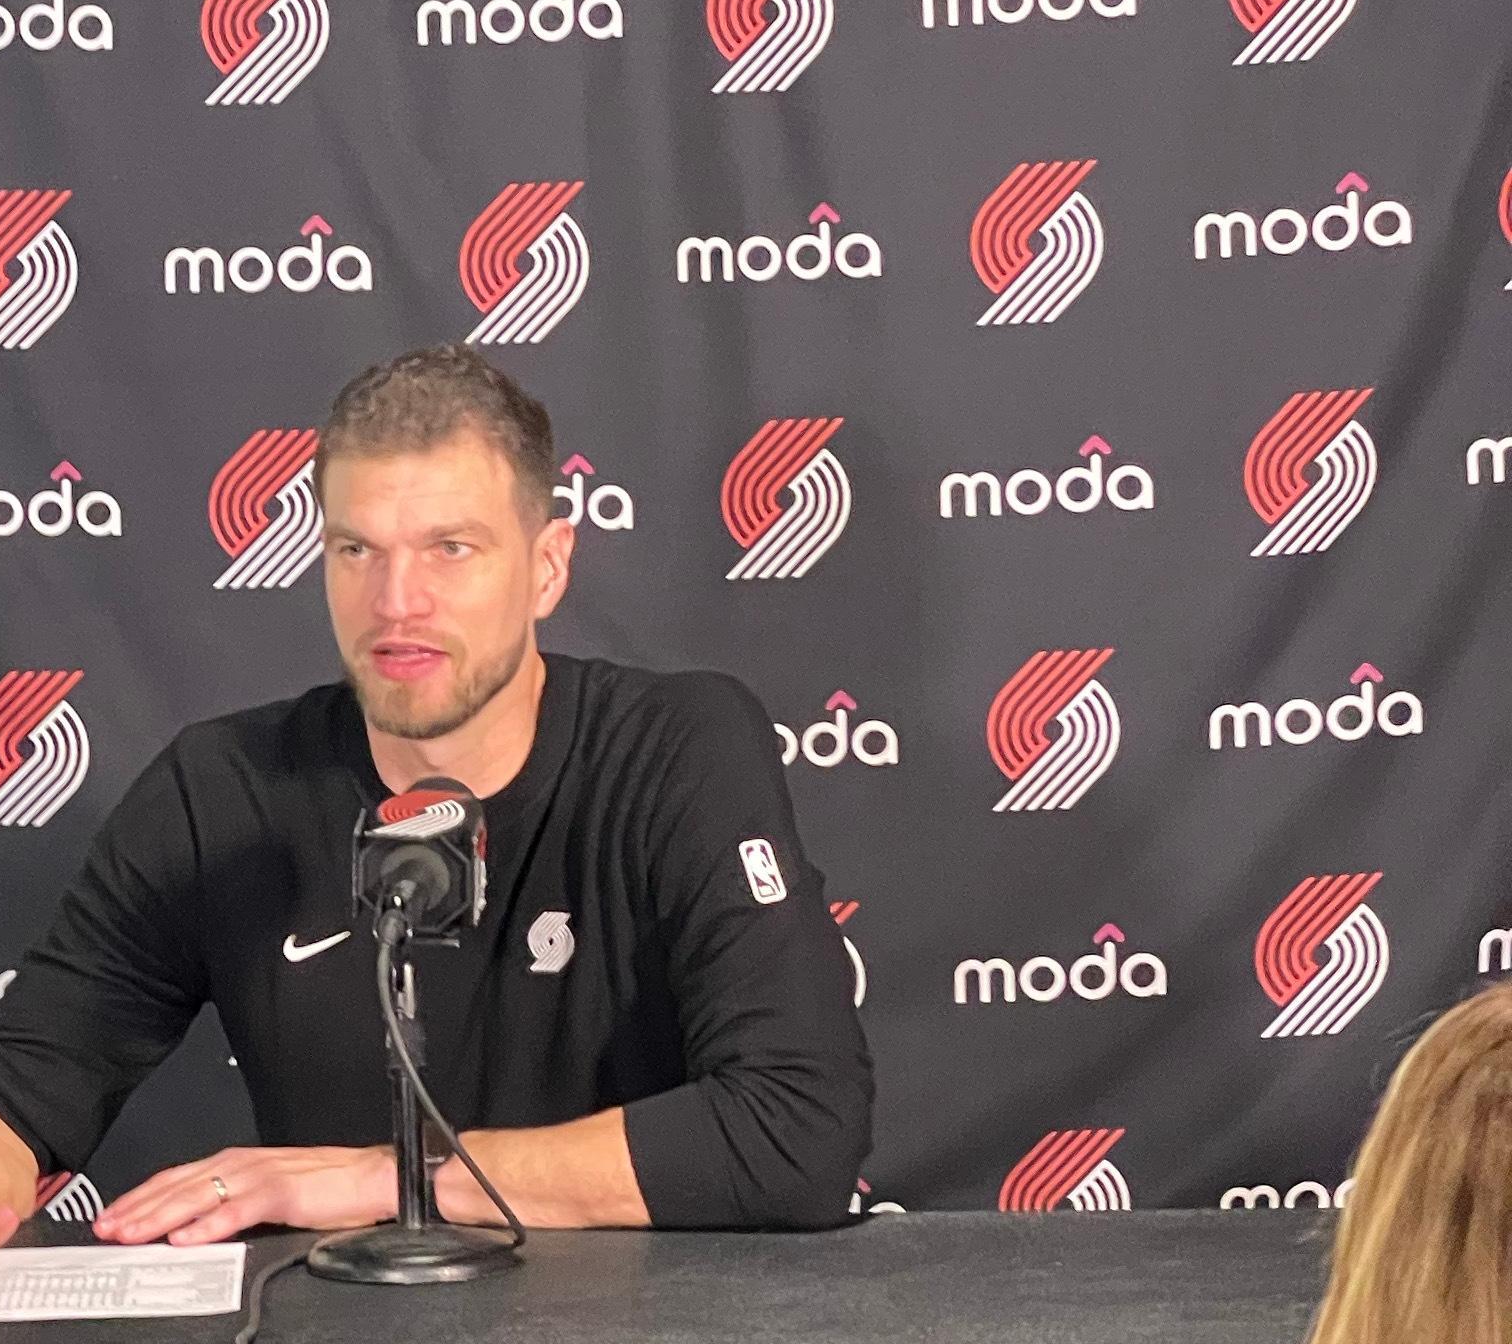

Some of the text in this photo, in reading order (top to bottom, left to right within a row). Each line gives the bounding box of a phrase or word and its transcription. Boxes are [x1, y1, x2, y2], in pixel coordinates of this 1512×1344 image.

[164, 215, 373, 294] moda
[677, 203, 882, 283] moda
[1194, 172, 1413, 259] moda
[940, 435, 1154, 518] moda
[1209, 663, 1423, 750] moda
[954, 924, 1167, 1004] moda
